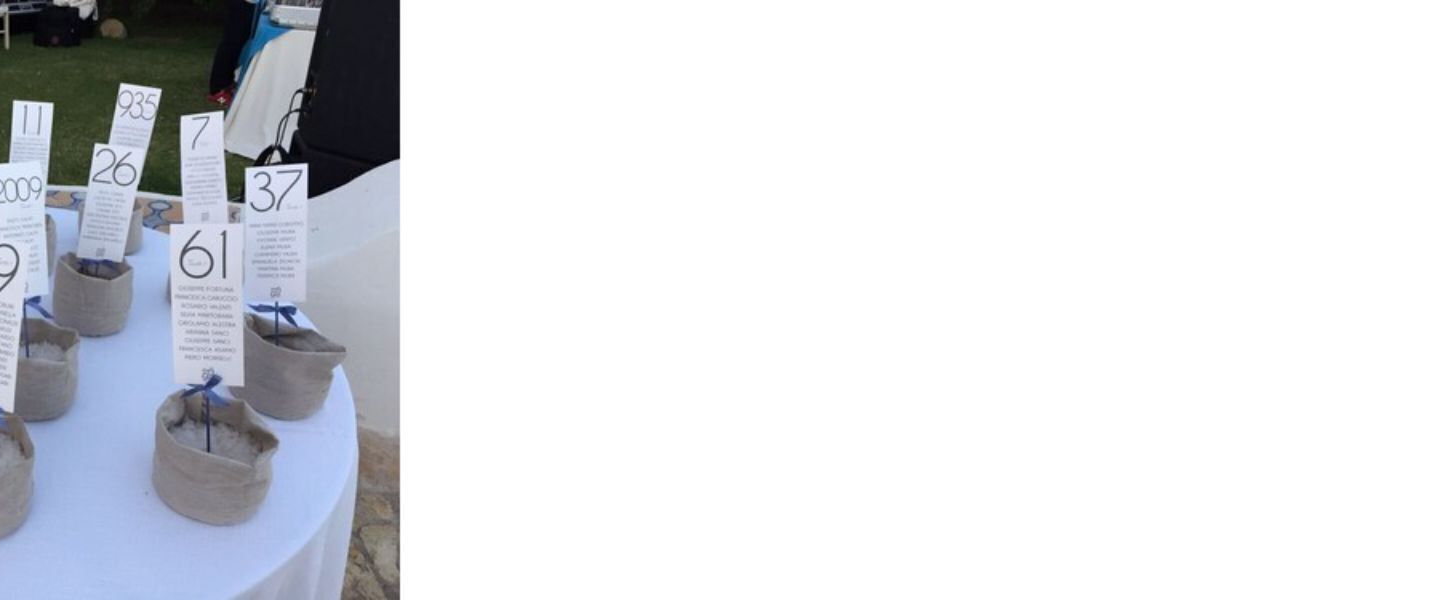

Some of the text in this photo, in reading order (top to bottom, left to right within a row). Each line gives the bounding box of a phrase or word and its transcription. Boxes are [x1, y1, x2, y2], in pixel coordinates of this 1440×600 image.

[22, 104, 42, 136] 11
[117, 90, 158, 120] 935
[191, 115, 210, 150] 7
[92, 148, 137, 187] 26
[250, 169, 303, 213] 37
[179, 229, 227, 279] 61
